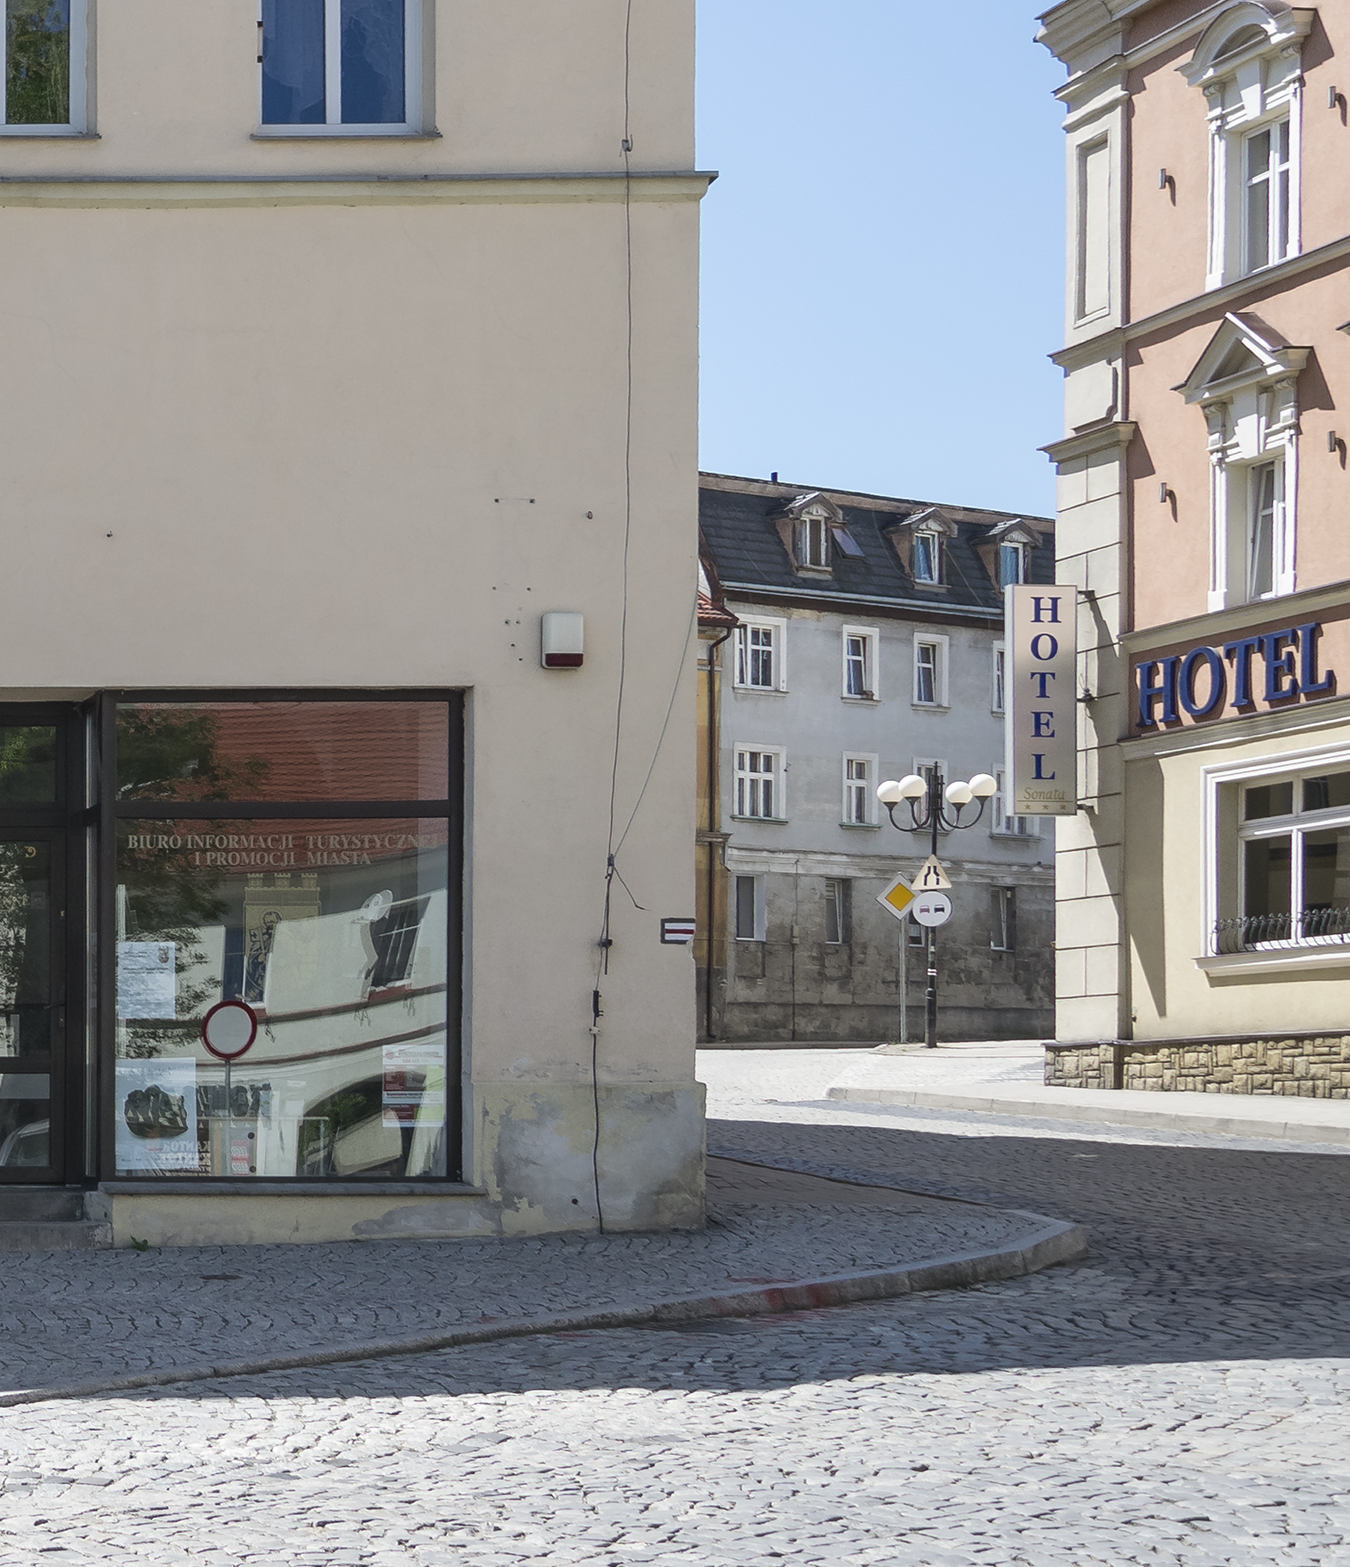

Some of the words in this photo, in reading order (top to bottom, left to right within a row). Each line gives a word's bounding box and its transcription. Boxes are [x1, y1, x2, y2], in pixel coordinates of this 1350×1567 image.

[1135, 621, 1335, 729] HOTEL
[1030, 596, 1062, 781] HOTEL
[1023, 786, 1066, 801] Sonata
[128, 835, 181, 850] BIURO
[186, 835, 294, 850] INFORMACJI
[194, 851, 200, 865] I
[205, 851, 296, 866] PROMOCJI
[307, 851, 371, 866] MIASTA
